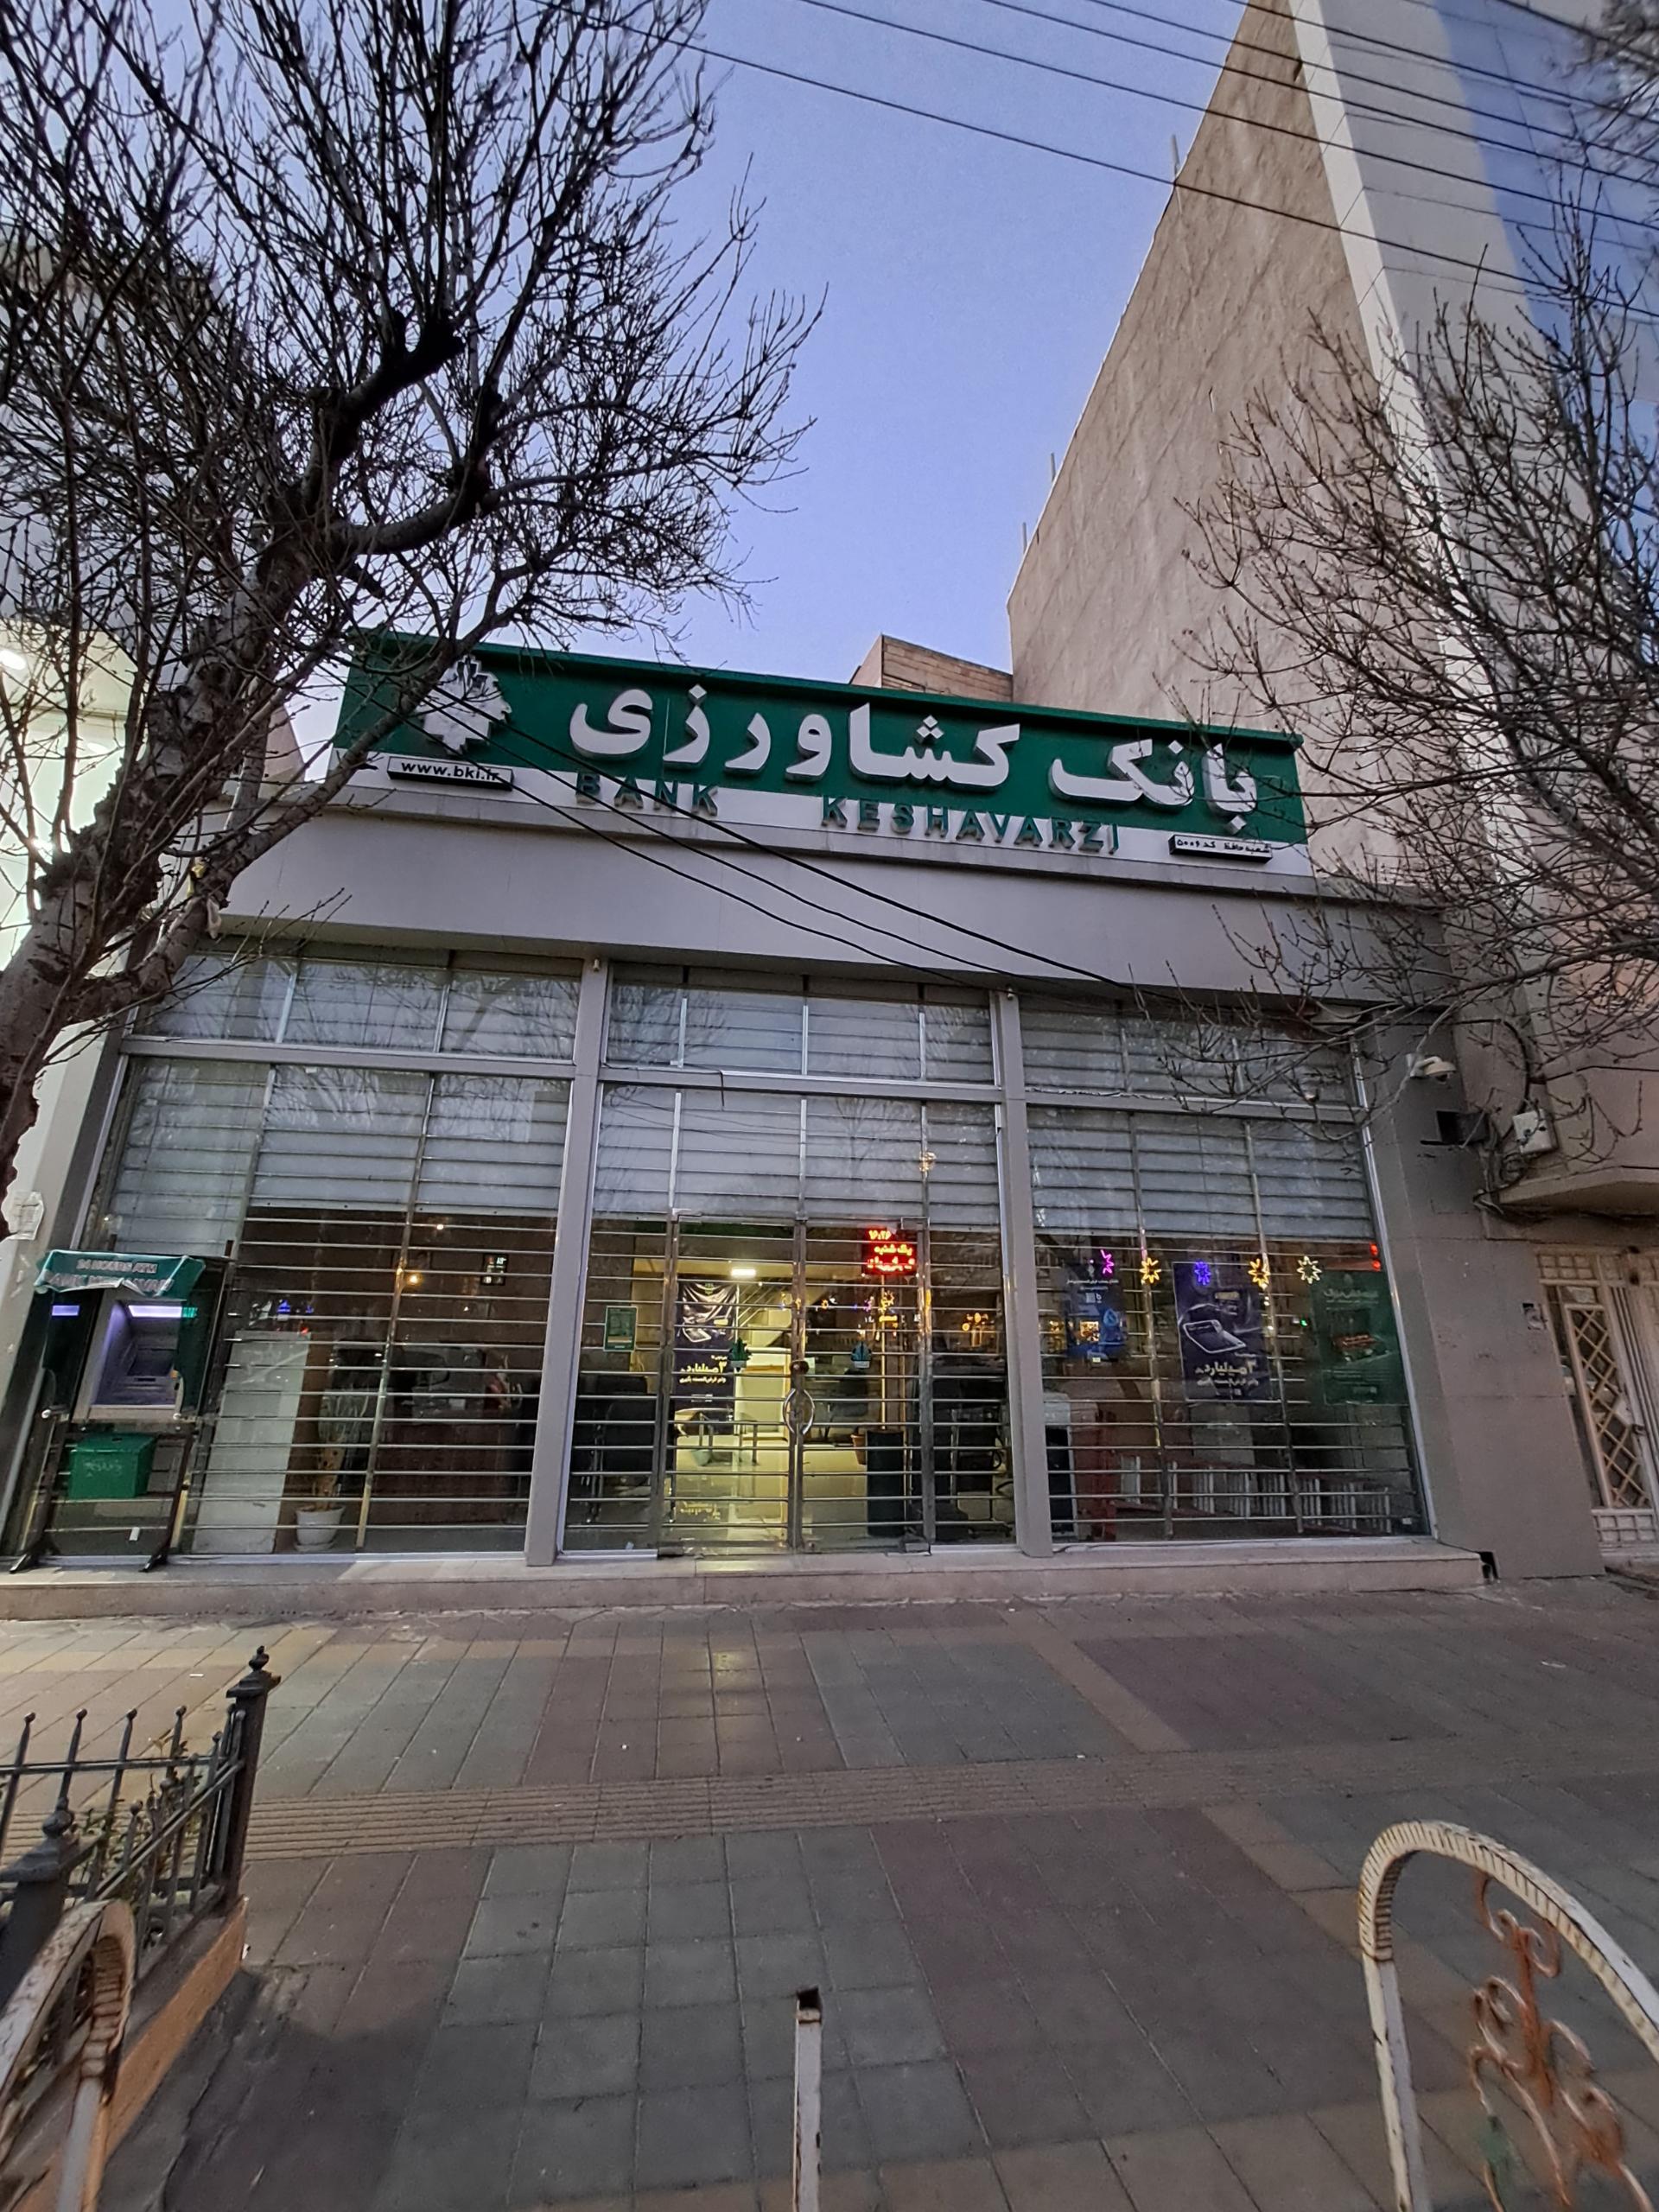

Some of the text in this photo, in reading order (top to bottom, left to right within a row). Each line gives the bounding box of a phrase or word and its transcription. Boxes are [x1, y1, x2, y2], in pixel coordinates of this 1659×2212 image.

[401, 762, 499, 781] www.bki.ir
[569, 684, 1258, 834] بانک کشاورزی
[575, 769, 1121, 855] BANK KESHAVARZI
